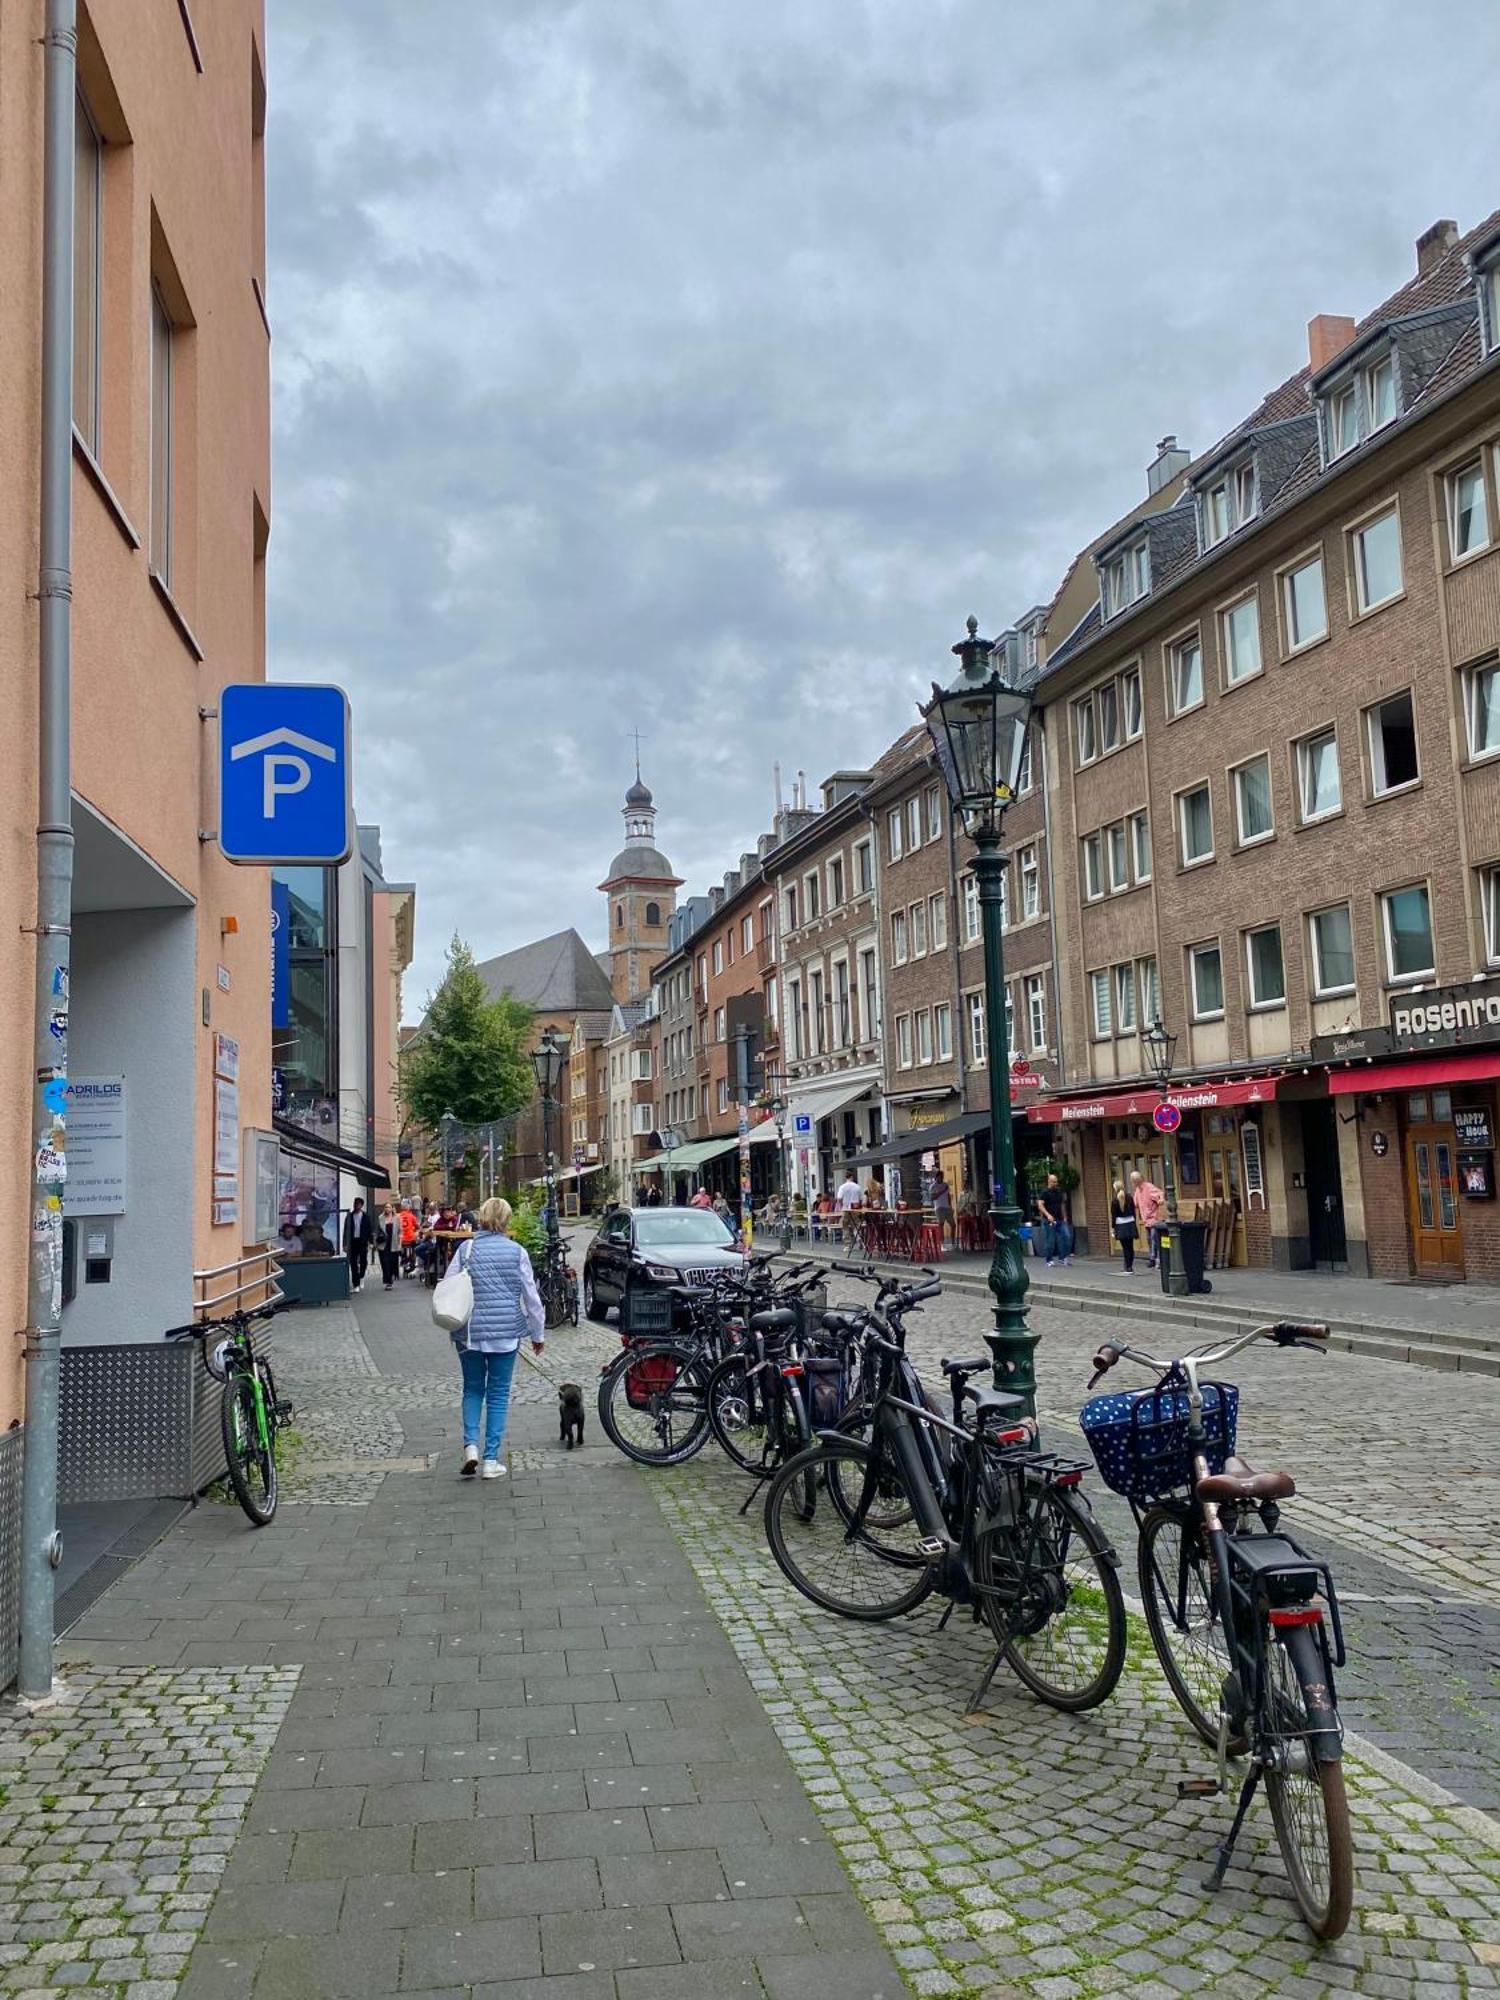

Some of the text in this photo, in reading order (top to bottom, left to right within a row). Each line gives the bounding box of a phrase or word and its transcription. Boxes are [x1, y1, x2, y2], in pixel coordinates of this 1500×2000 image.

[264, 754, 311, 818] P
[799, 1118, 807, 1129] P
[1455, 1112, 1484, 1126] HAPPY
